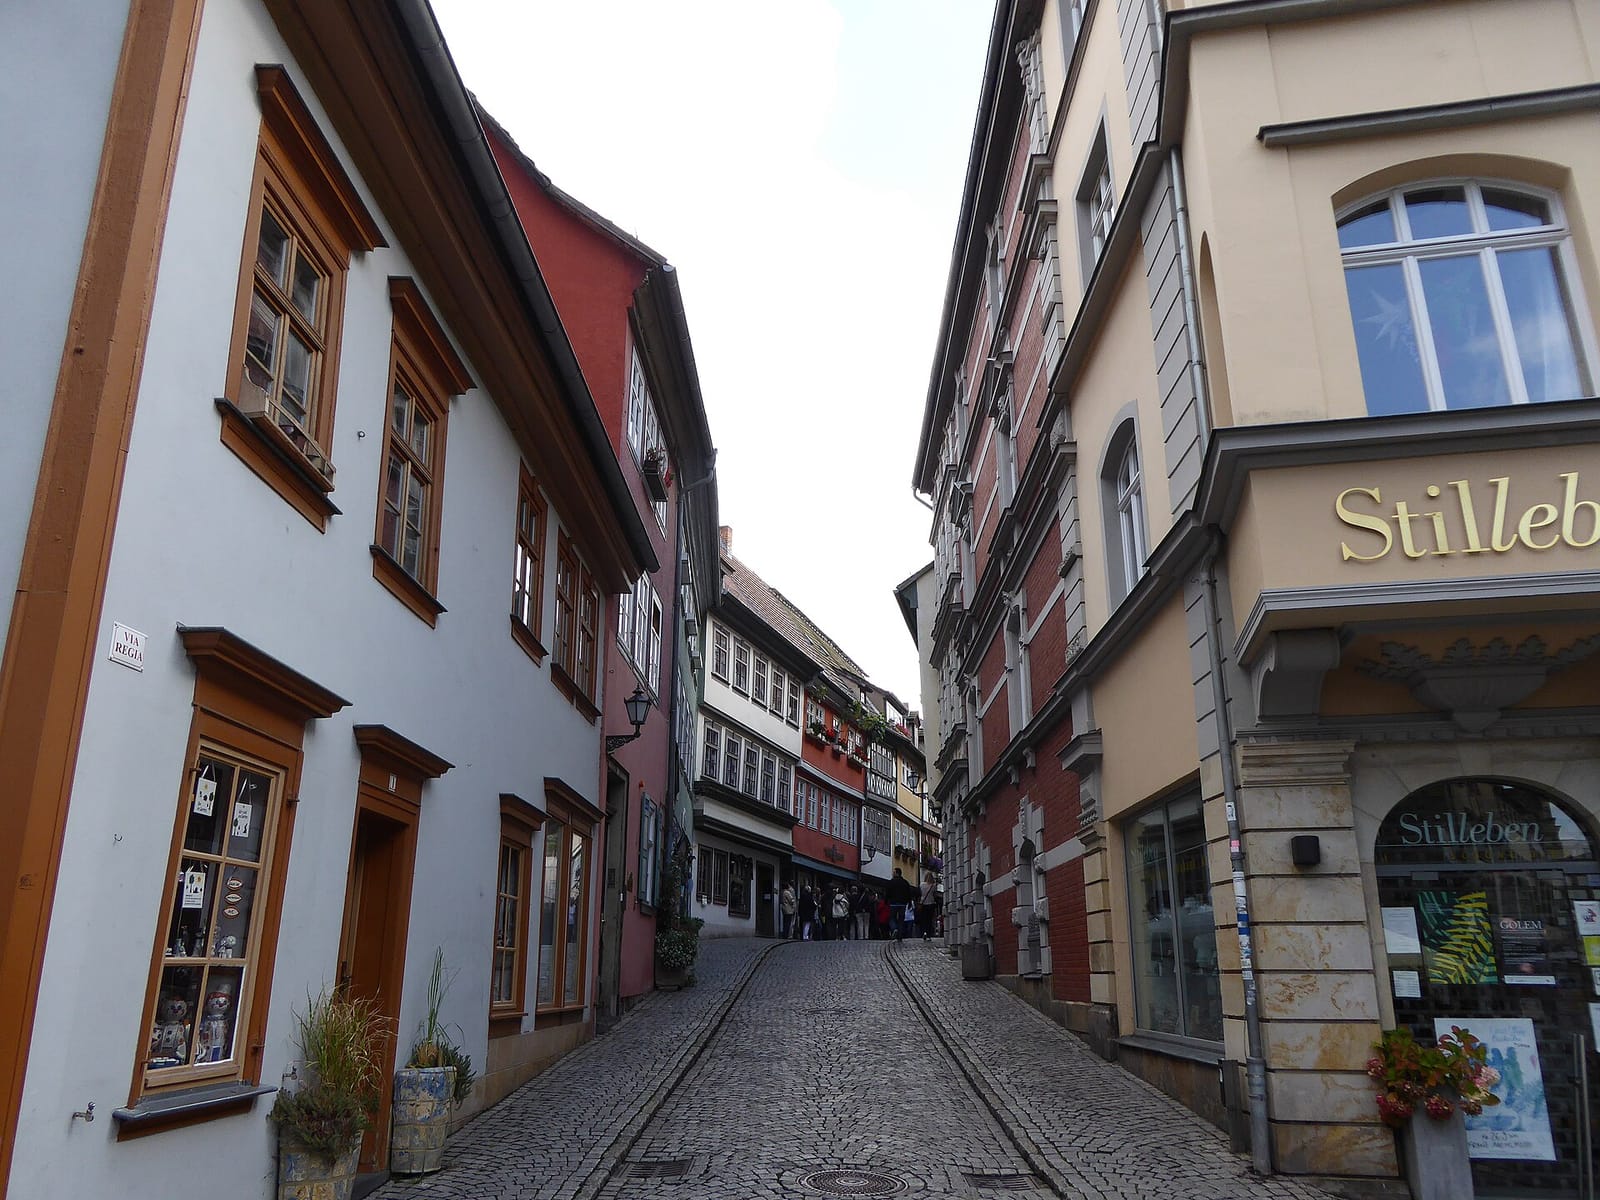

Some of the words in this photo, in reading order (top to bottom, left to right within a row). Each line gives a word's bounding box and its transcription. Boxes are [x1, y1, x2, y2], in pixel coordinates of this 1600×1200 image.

[1335, 472, 1600, 561] Stilleb
[124, 631, 139, 647] VIA
[115, 642, 142, 662] REGIA
[1400, 811, 1544, 845] Stilleben
[1500, 920, 1542, 930] GOLEM
